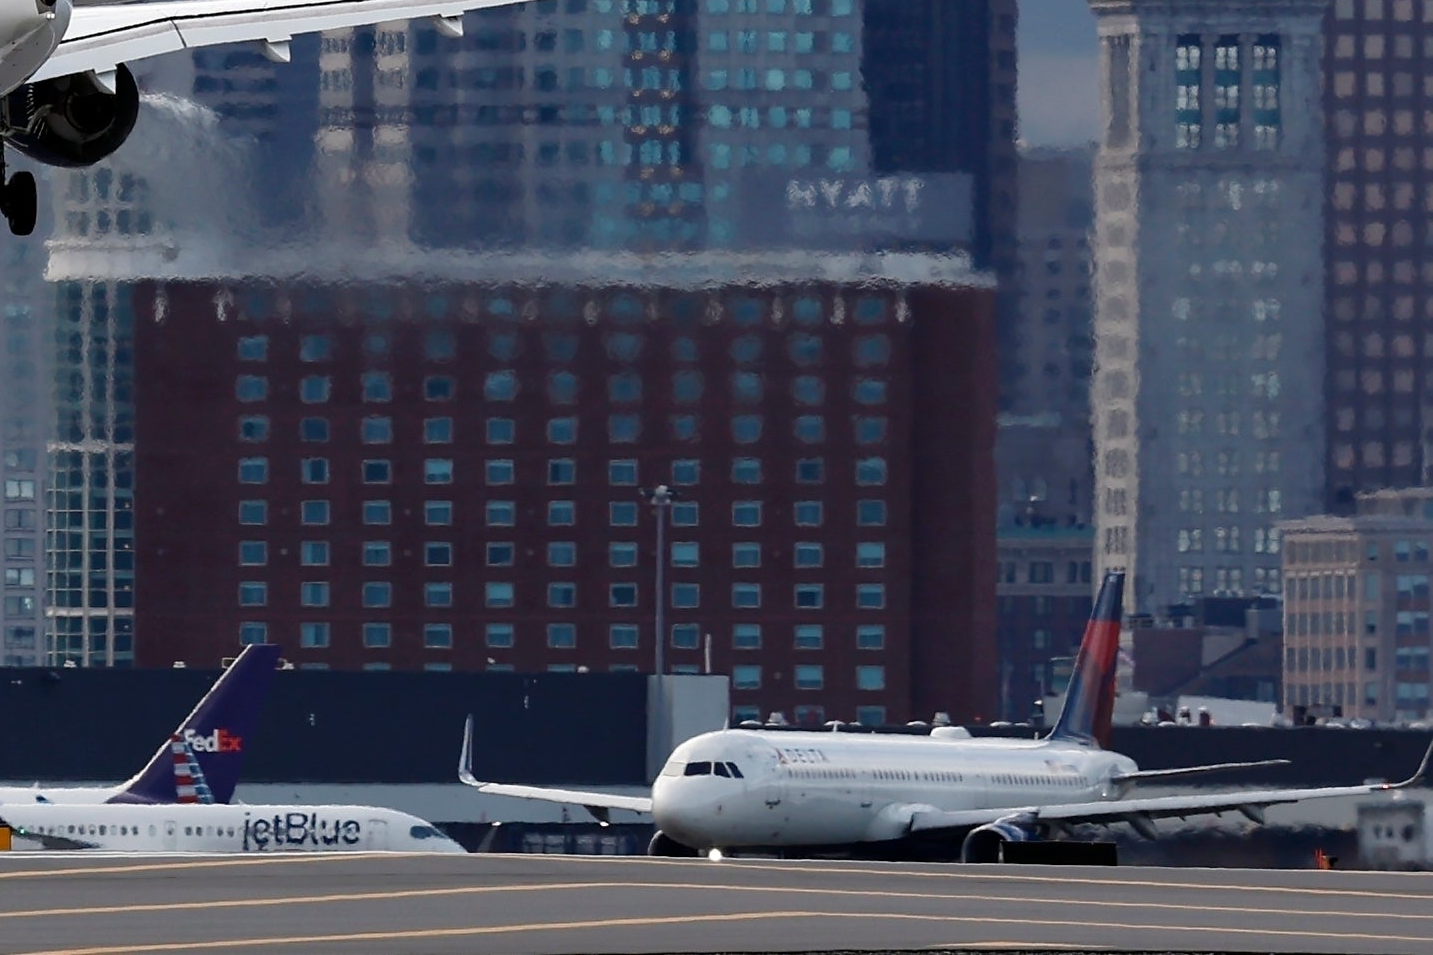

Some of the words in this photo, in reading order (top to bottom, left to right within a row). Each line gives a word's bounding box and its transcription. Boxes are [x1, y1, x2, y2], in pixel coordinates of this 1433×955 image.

[786, 179, 924, 212] HYATT
[184, 729, 242, 752] FedEx
[243, 812, 360, 850] jetBlue
